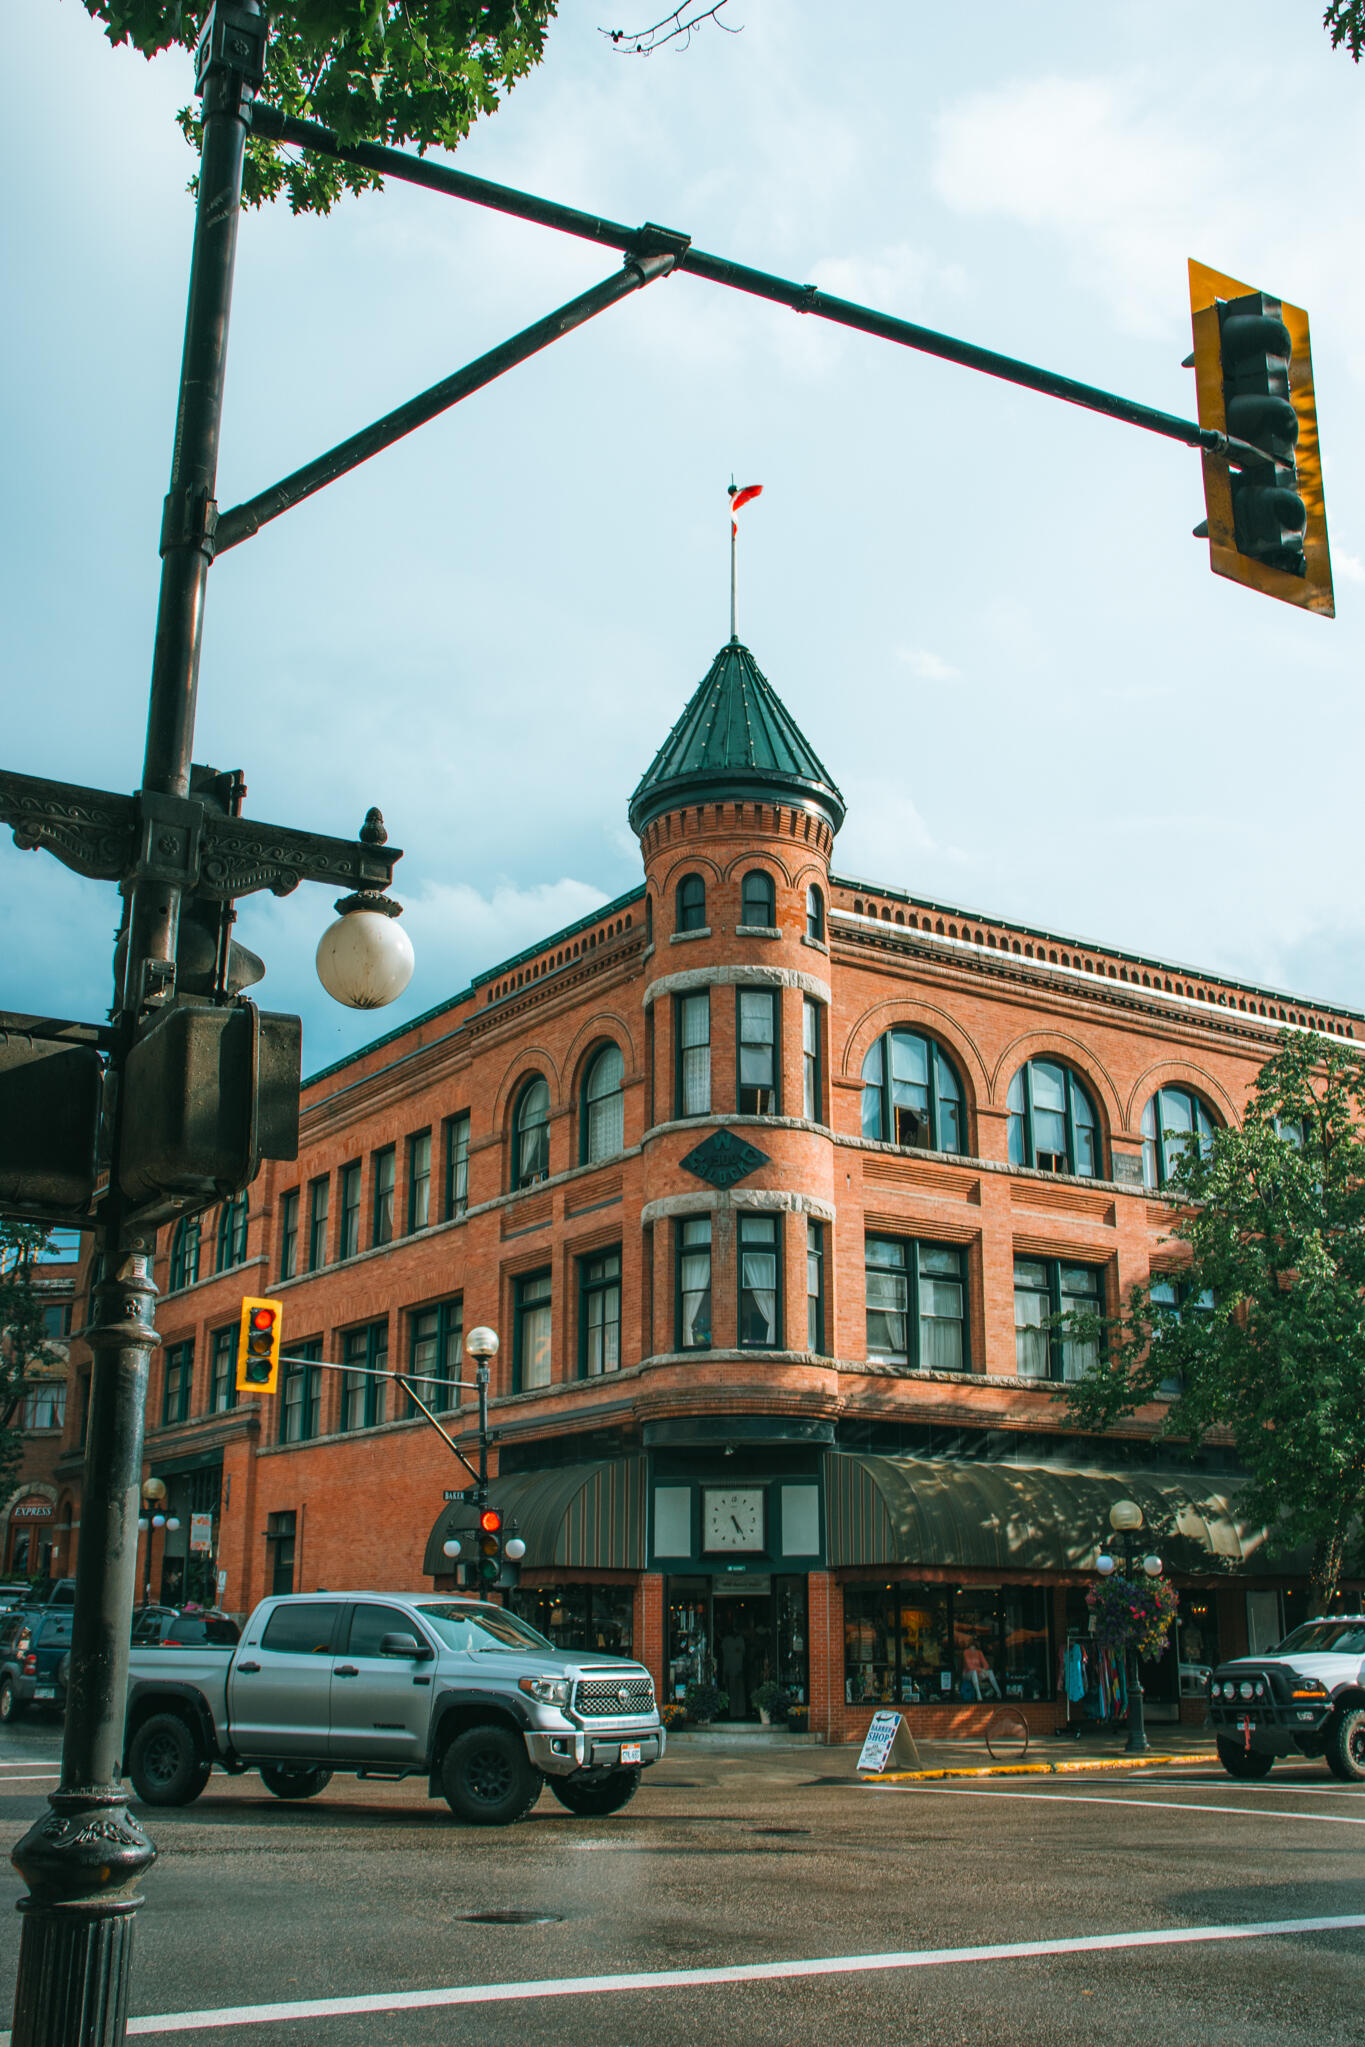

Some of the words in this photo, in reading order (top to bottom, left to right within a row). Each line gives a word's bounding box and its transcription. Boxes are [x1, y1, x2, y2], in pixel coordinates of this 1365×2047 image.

[713, 1134, 732, 1150] W
[741, 1146, 757, 1164] C
[699, 1161, 749, 1184] BLOCK
[444, 1491, 465, 1500] BAKER
[15, 1507, 53, 1517] EXPRESS
[868, 1731, 890, 1743] SHOP
